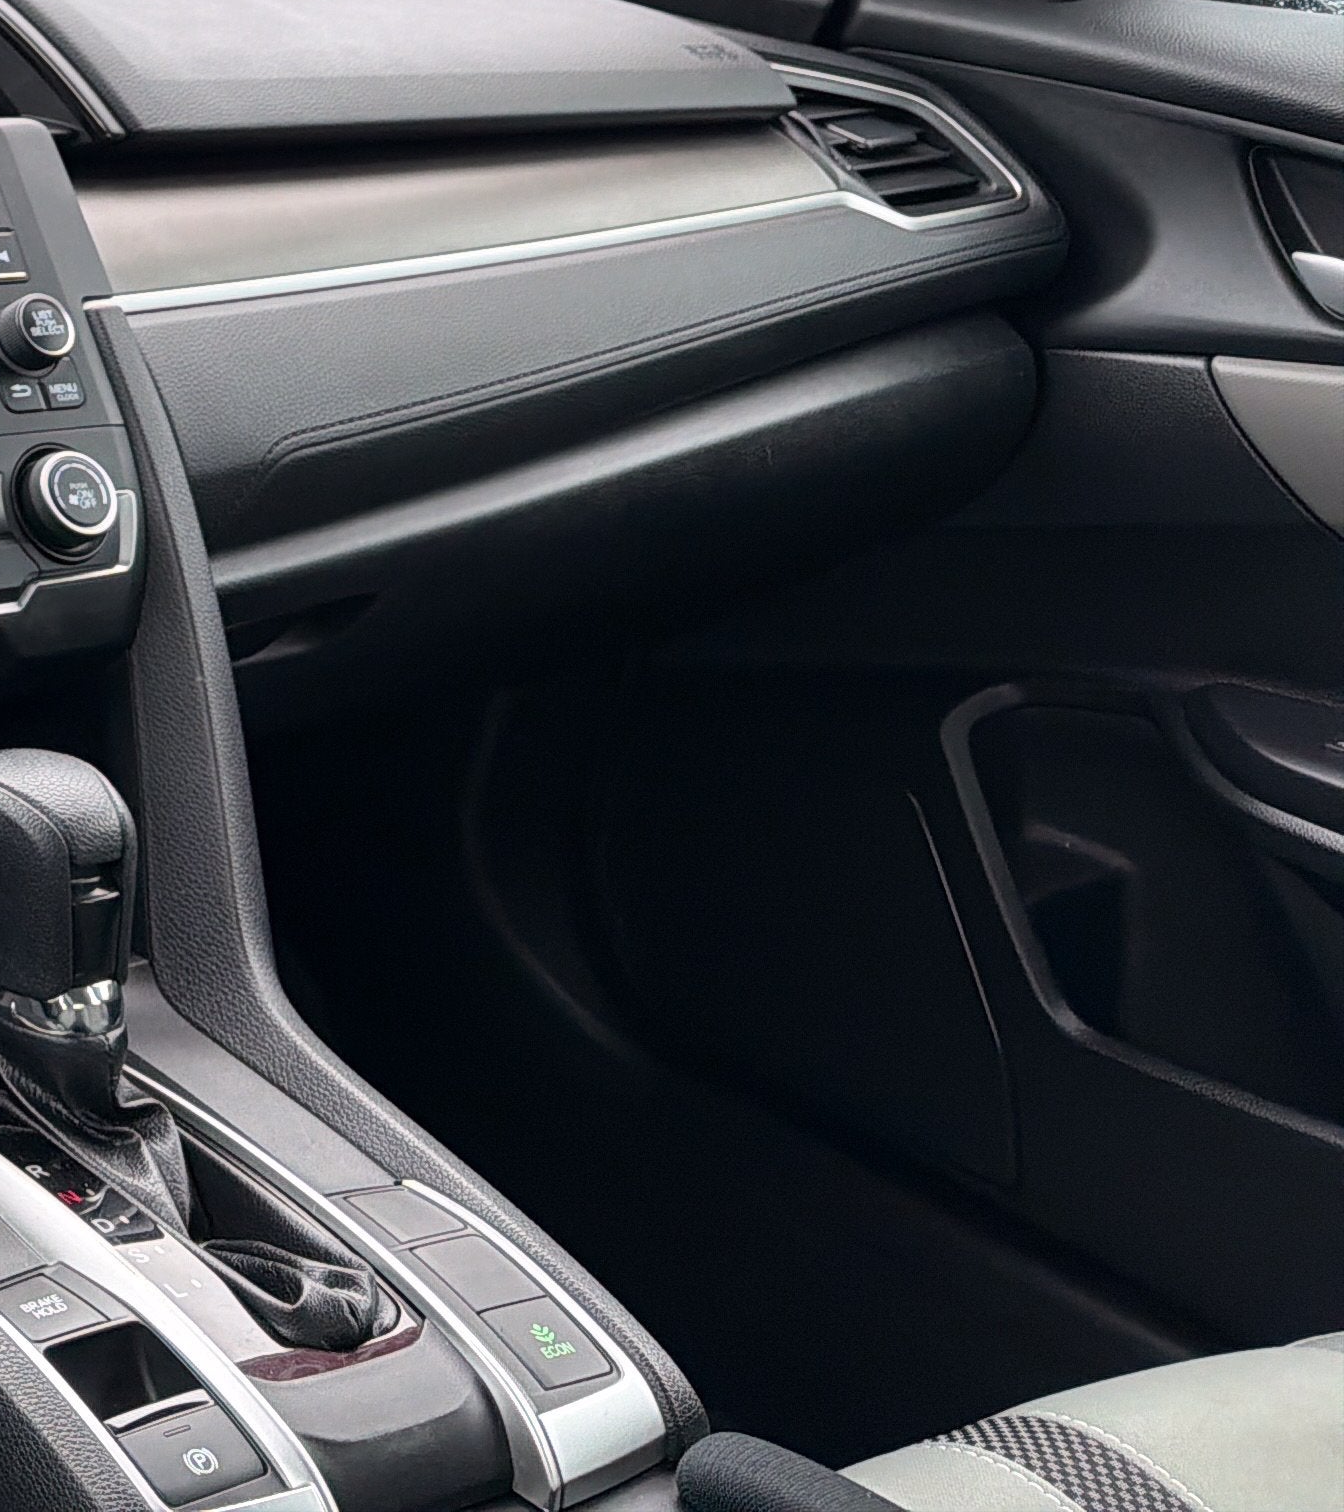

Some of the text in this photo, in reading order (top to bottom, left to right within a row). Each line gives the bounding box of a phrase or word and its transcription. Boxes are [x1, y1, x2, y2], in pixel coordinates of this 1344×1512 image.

[25, 1164, 51, 1179] R
[90, 1218, 115, 1234] D
[127, 1248, 150, 1264] S
[163, 1283, 189, 1298] L
[19, 1293, 64, 1314] BRAKE
[32, 1303, 68, 1320] HOLD
[540, 1341, 576, 1360] ECON
